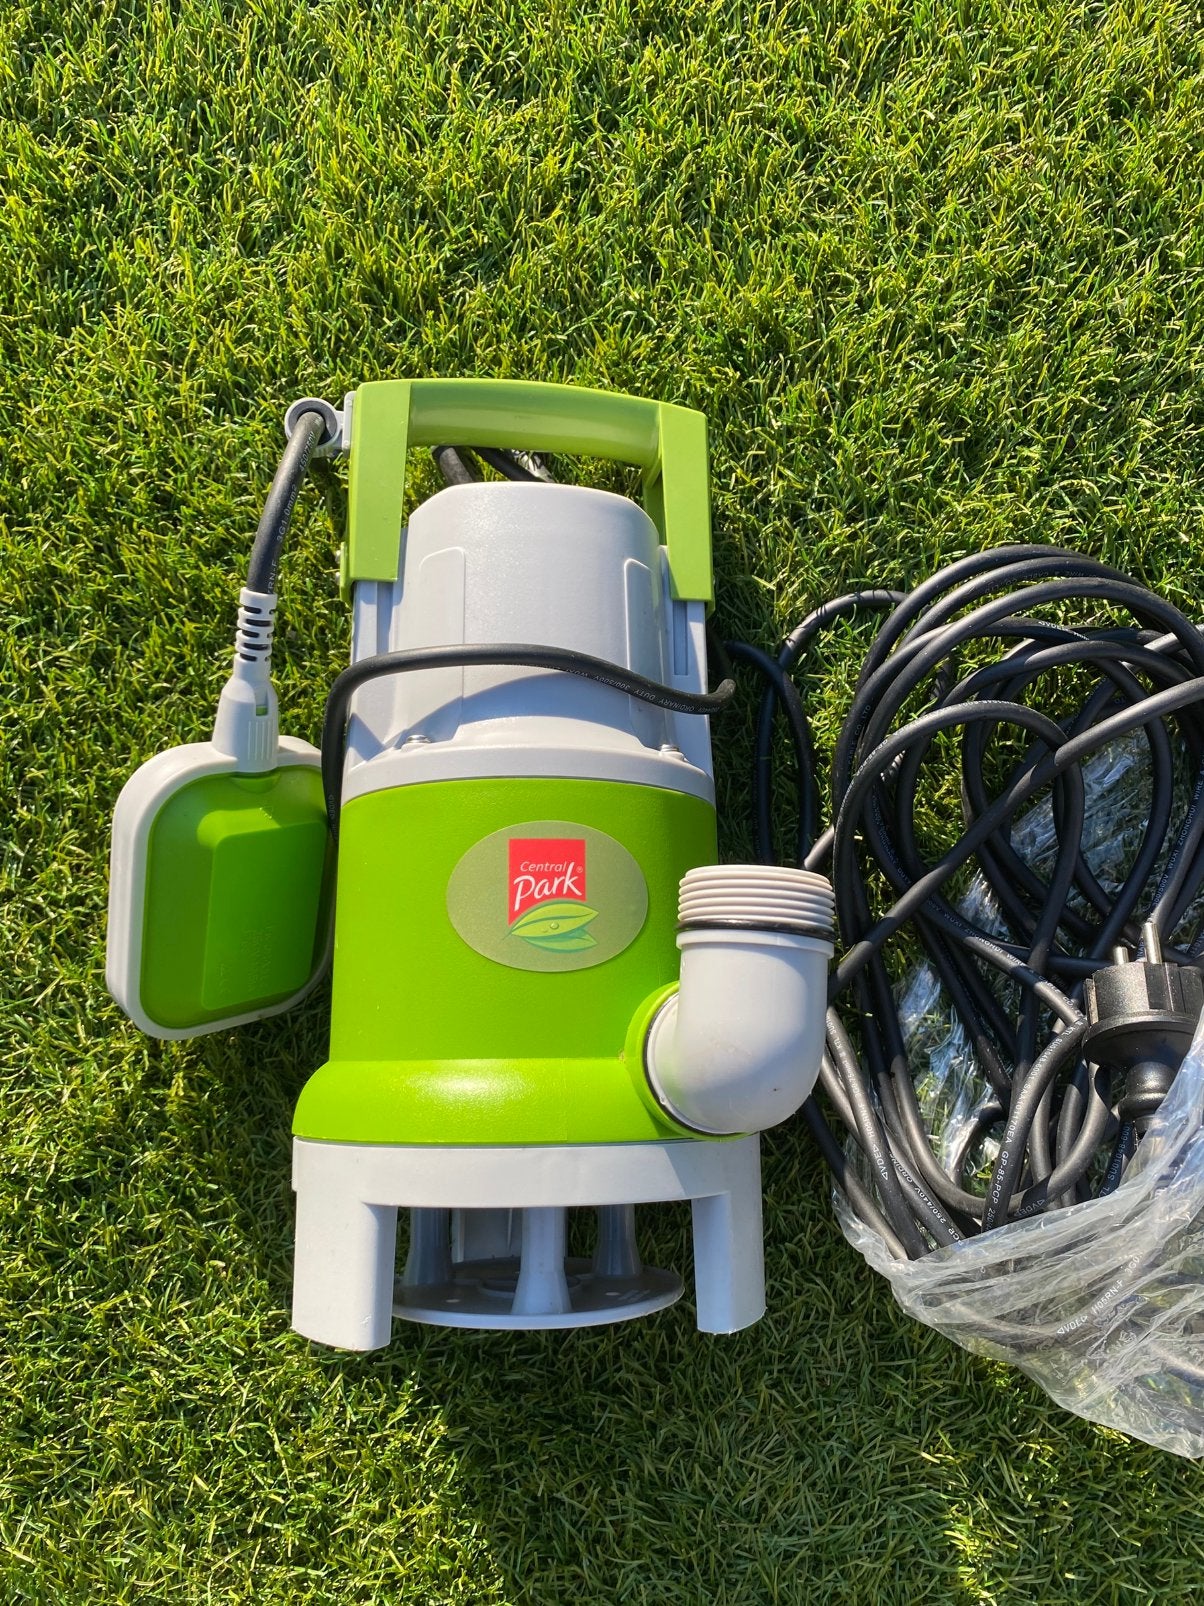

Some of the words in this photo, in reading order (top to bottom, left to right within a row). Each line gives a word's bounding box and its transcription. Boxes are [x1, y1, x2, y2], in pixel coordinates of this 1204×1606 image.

[635, 689, 656, 701] DUTY
[1167, 849, 1180, 869] WUXI
[1178, 804, 1197, 846] ZHONGHUI
[513, 861, 583, 912] Park
[520, 861, 567, 872] Central
[993, 1150, 1009, 1204] GP-85-PCP
[914, 1186, 947, 1224] 250/440V
